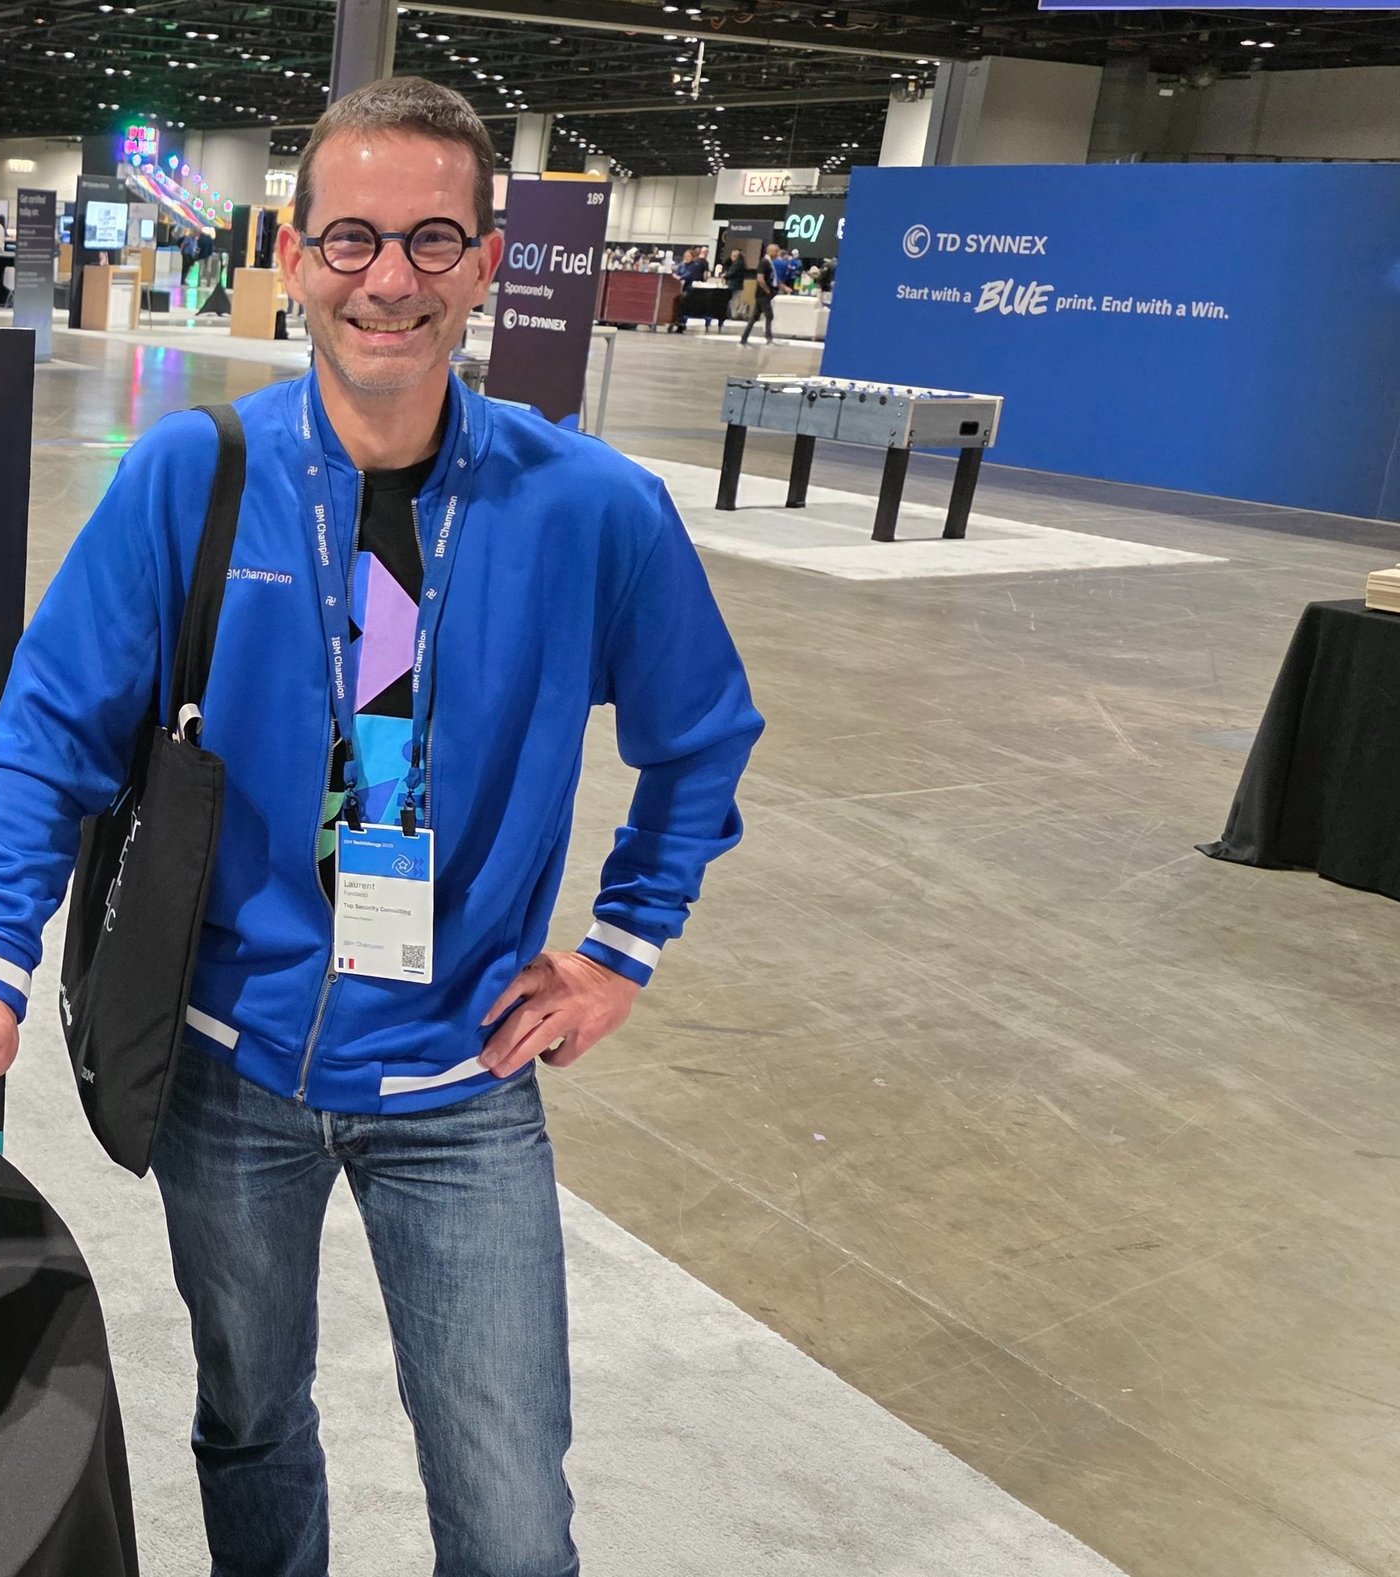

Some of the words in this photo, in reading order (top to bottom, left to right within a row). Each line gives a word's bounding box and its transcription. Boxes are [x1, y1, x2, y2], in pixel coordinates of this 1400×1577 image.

[748, 176, 782, 193] EXIT
[587, 192, 605, 205] 189
[784, 214, 825, 242] GO/
[936, 233, 961, 252] TD
[965, 234, 1048, 255] SYNNEX
[508, 242, 547, 276] GO/
[549, 245, 593, 276] Fuel
[504, 281, 543, 297] Sponsored
[543, 287, 554, 300] by
[896, 284, 928, 301] Start
[931, 287, 960, 303] with
[963, 292, 971, 303] a
[973, 278, 1054, 316] BLUE
[1055, 294, 1097, 312] print.
[1101, 296, 1133, 313] End
[1136, 298, 1172, 316] with
[1176, 303, 1186, 317] a
[1191, 301, 1229, 320] Win.
[518, 314, 530, 326] TD
[530, 316, 567, 332] SYNNEX
[314, 504, 325, 523] IBM
[440, 495, 458, 538] Champion
[317, 523, 330, 566] Champion
[434, 539, 447, 558] IBM
[226, 568, 240, 580] BM
[241, 567, 292, 584] Champion
[331, 636, 342, 654] IBM
[413, 629, 427, 673] Champion
[333, 654, 345, 699] Champion
[412, 673, 422, 693] IBM
[343, 879, 375, 890] Laurent
